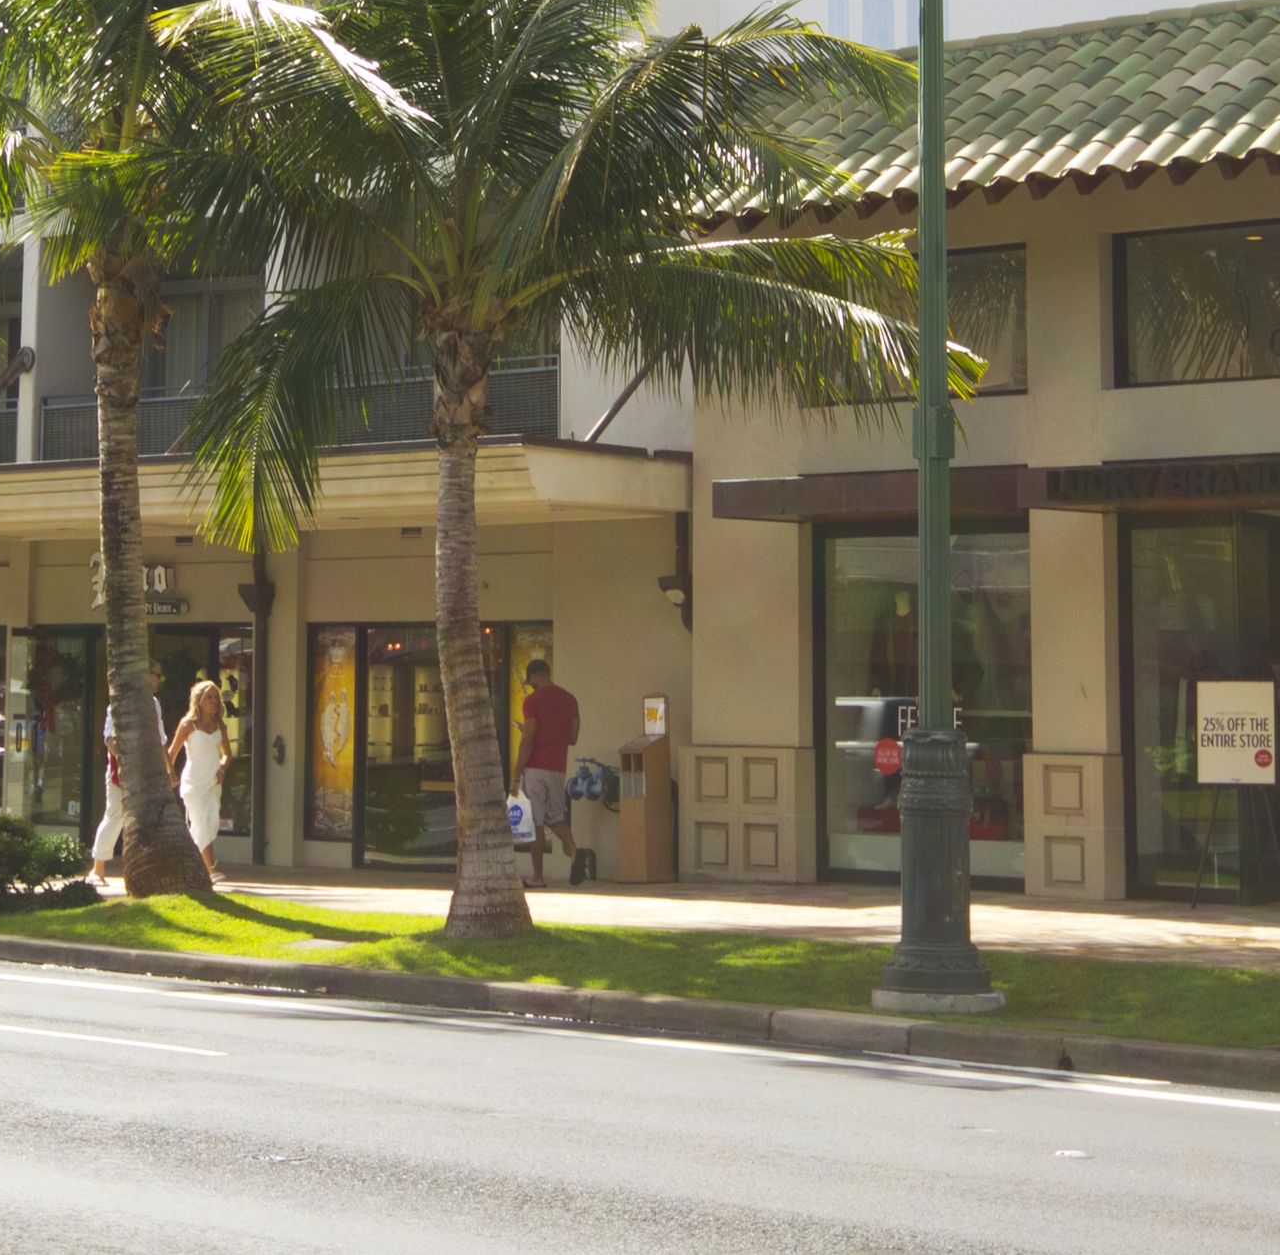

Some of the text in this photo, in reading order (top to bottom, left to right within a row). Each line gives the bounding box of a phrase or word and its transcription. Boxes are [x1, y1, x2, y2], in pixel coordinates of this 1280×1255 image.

[1046, 465, 1162, 501] LUCKY
[1203, 717, 1269, 732] 25% OFF THE
[1200, 733, 1272, 748] ENTIRE STORE
